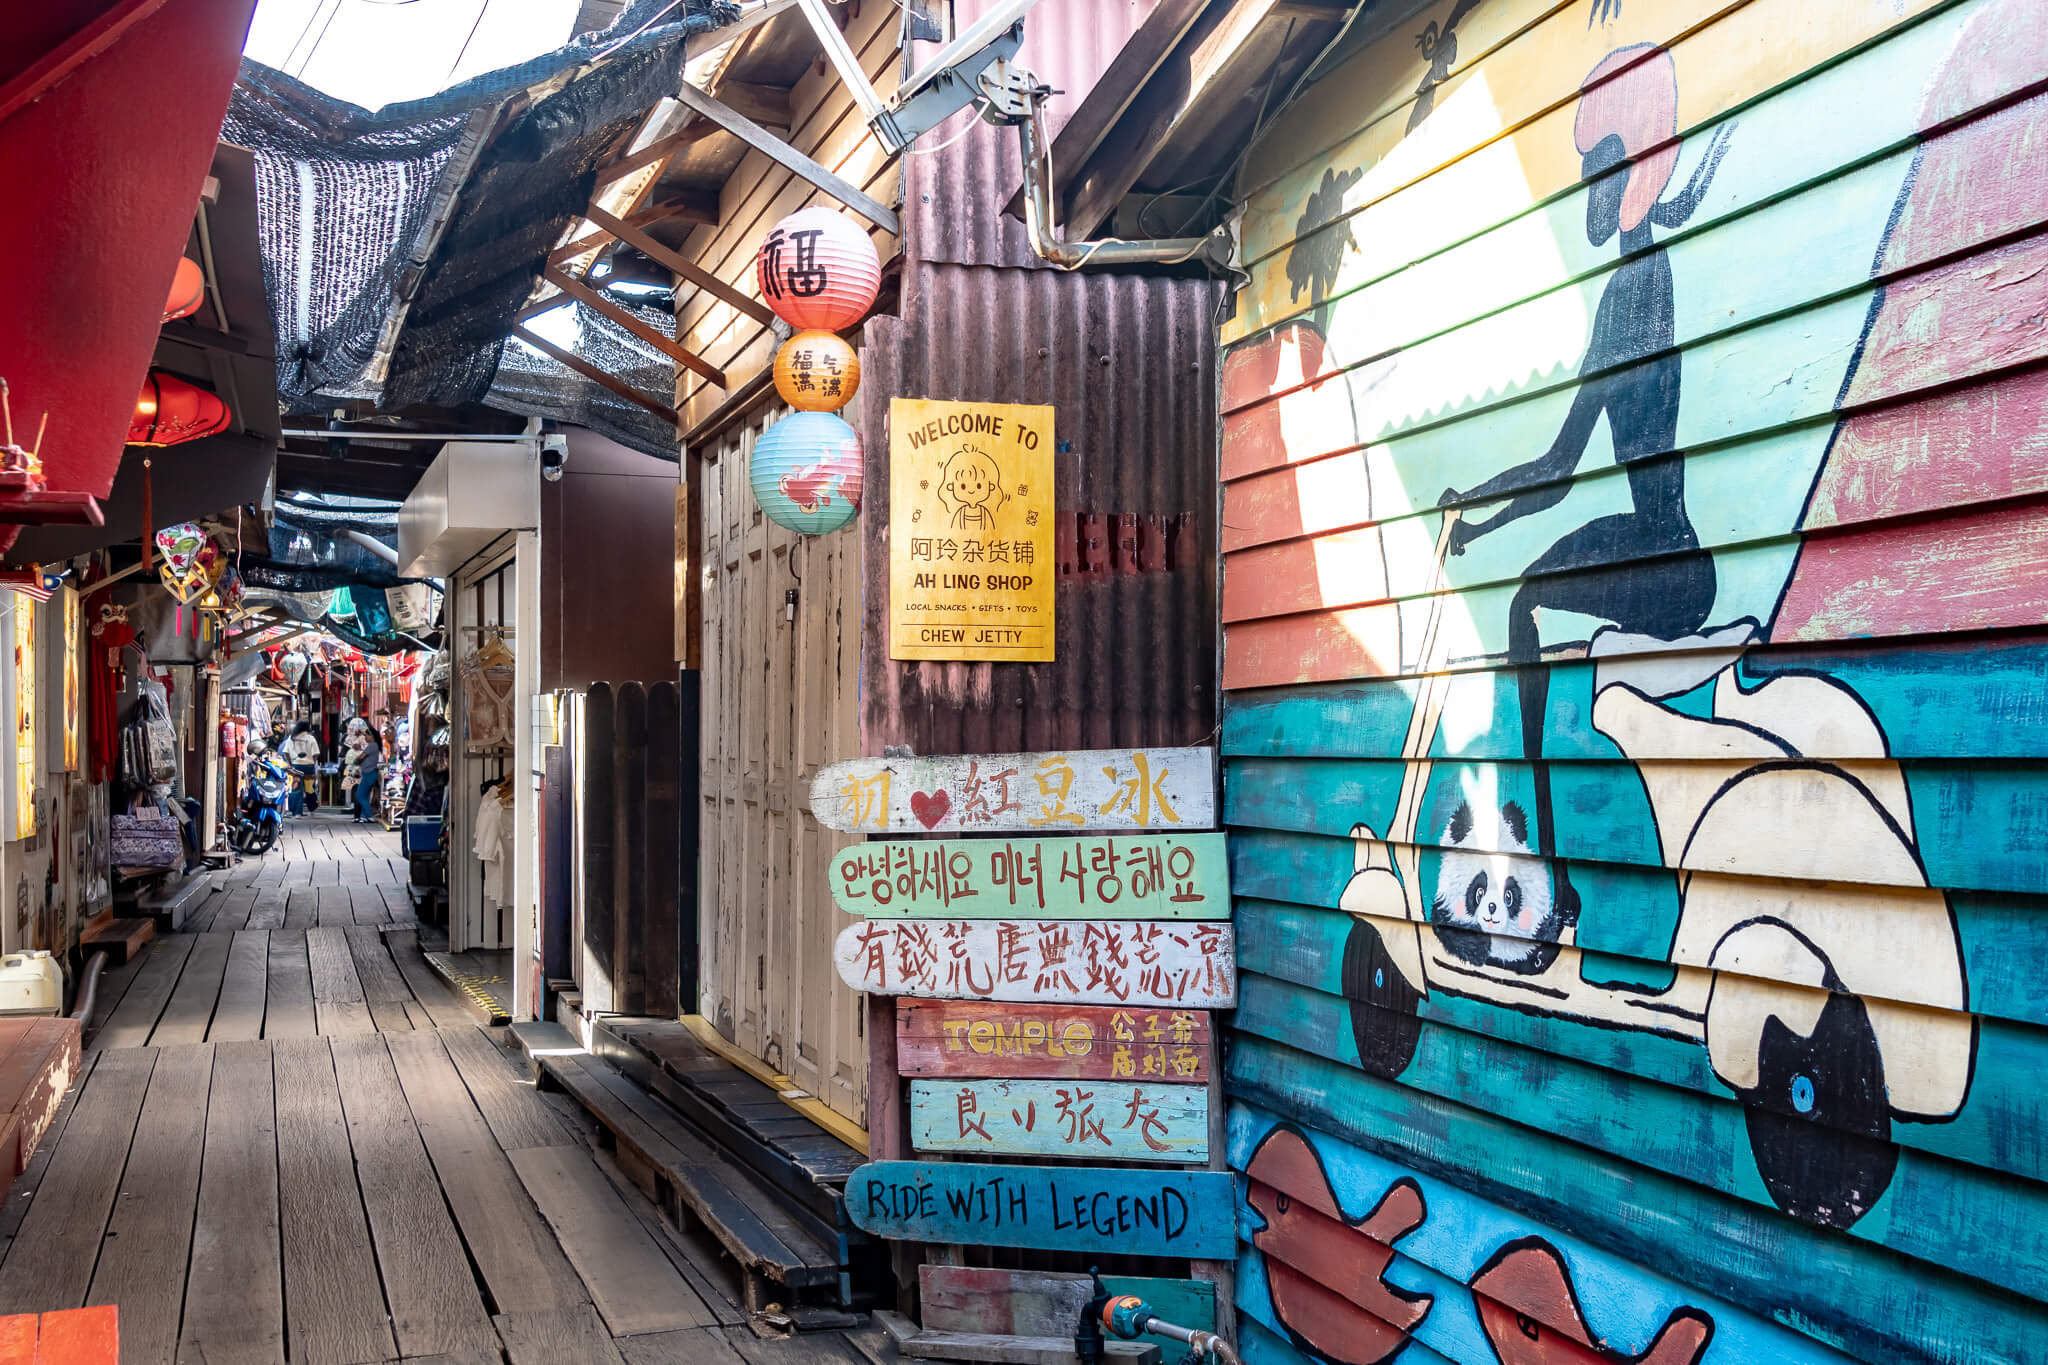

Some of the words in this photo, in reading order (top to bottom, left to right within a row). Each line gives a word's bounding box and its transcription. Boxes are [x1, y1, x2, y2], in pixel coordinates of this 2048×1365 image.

[764, 229, 827, 300] 福
[908, 413, 1004, 450] WELCOME
[1016, 424, 1039, 450] TO
[911, 538, 1034, 565] 阿玲杂货铺
[914, 573, 936, 588] AH
[943, 574, 980, 590] LING
[987, 575, 1033, 590] SHOP
[906, 603, 931, 611] LOCAL
[934, 604, 967, 612] SNACKS
[979, 604, 1004, 612] GIFTS
[1016, 605, 1038, 613] TOYS
[921, 629, 965, 643] CHEW
[975, 630, 1023, 643] JETTY
[959, 753, 1180, 828] 紅豆冰
[840, 844, 979, 908] 안녕하세요
[991, 843, 1046, 908] 미녀
[1060, 838, 1205, 904] 사랑해요
[867, 1179, 938, 1224] RIDE
[946, 1177, 1028, 1227] WITH
[1051, 1181, 1188, 1242] LEGEND
